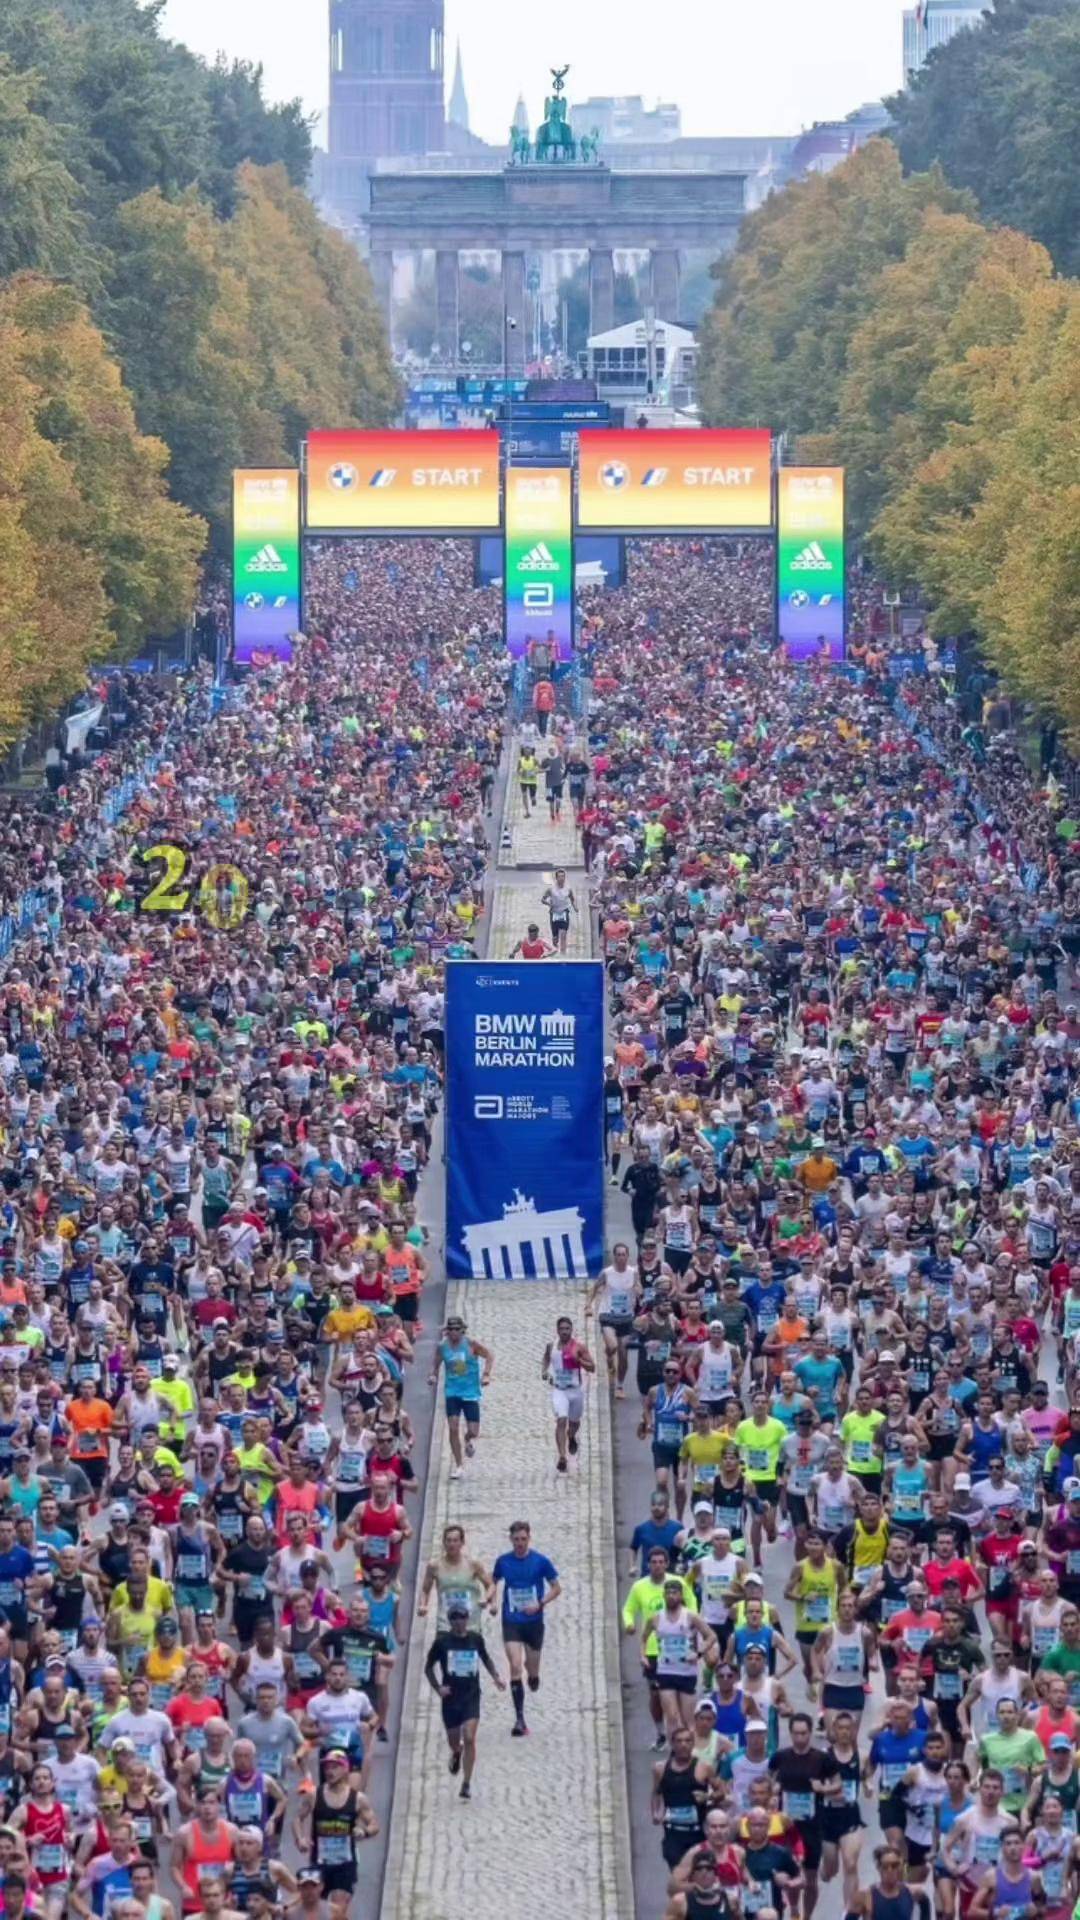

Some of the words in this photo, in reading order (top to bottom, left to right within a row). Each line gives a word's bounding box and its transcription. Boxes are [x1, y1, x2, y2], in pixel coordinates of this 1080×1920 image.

[412, 468, 483, 486] START
[683, 467, 755, 486] START
[244, 561, 289, 572] adidas
[516, 560, 560, 571] adidas
[790, 560, 833, 571] adidas
[475, 1014, 536, 1034] BMW
[475, 1036, 537, 1050] BERLIN
[475, 1053, 575, 1067] MARATHON
